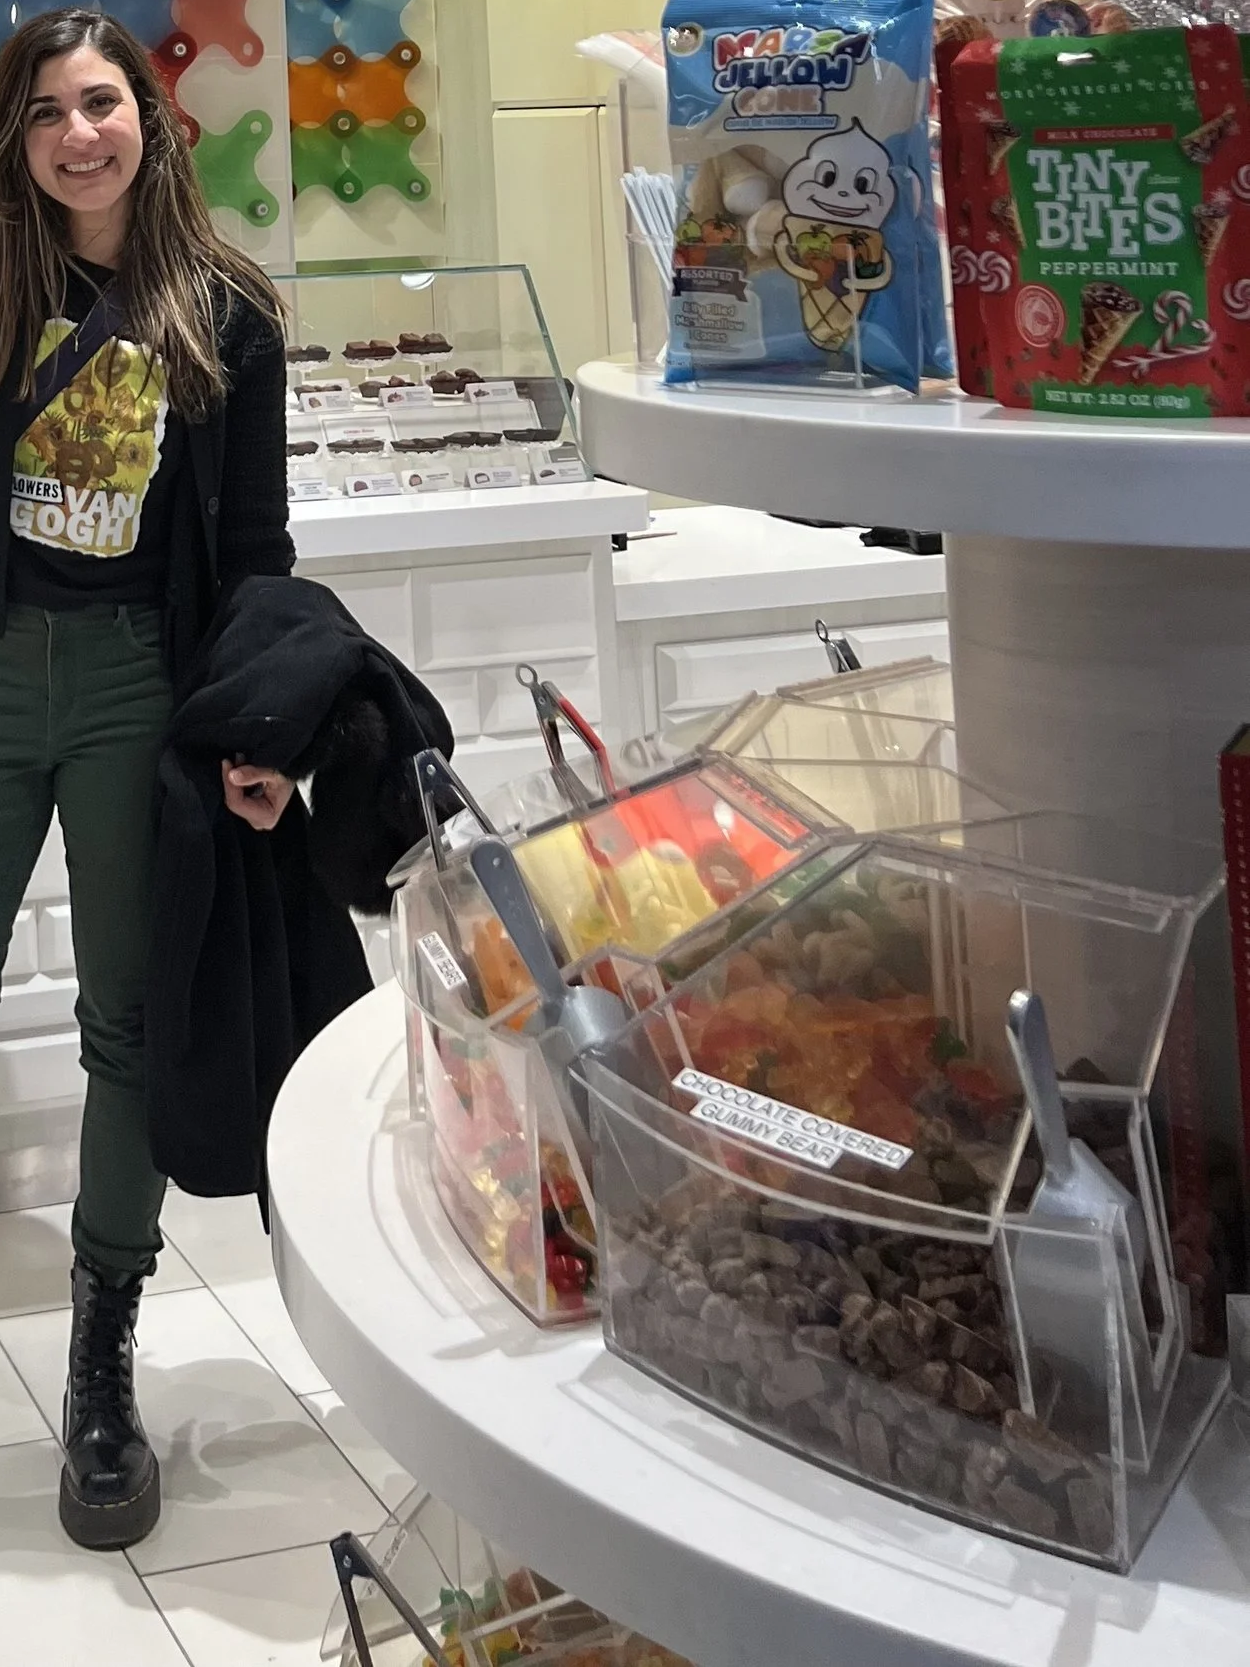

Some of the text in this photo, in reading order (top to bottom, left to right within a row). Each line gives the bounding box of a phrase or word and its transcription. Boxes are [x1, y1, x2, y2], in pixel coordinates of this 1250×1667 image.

[717, 55, 850, 89] JELLOW
[736, 85, 821, 114] CONE
[986, 87, 1035, 101] MORE
[1046, 83, 1133, 98] CRUNCHY
[1026, 148, 1150, 207] TINY
[1034, 191, 1185, 258] BITES
[680, 269, 734, 281] ASSORTED
[1038, 261, 1180, 276] PEPPERMINT
[1044, 389, 1068, 403] NET
[1128, 394, 1151, 407] OZ
[12, 476, 60, 499] LOWERS
[65, 485, 137, 518] VAN
[10, 499, 126, 547] GOGH
[680, 1071, 906, 1163] CHOCOLATE COVERED
[700, 1102, 836, 1162] GUMMY BEAR
